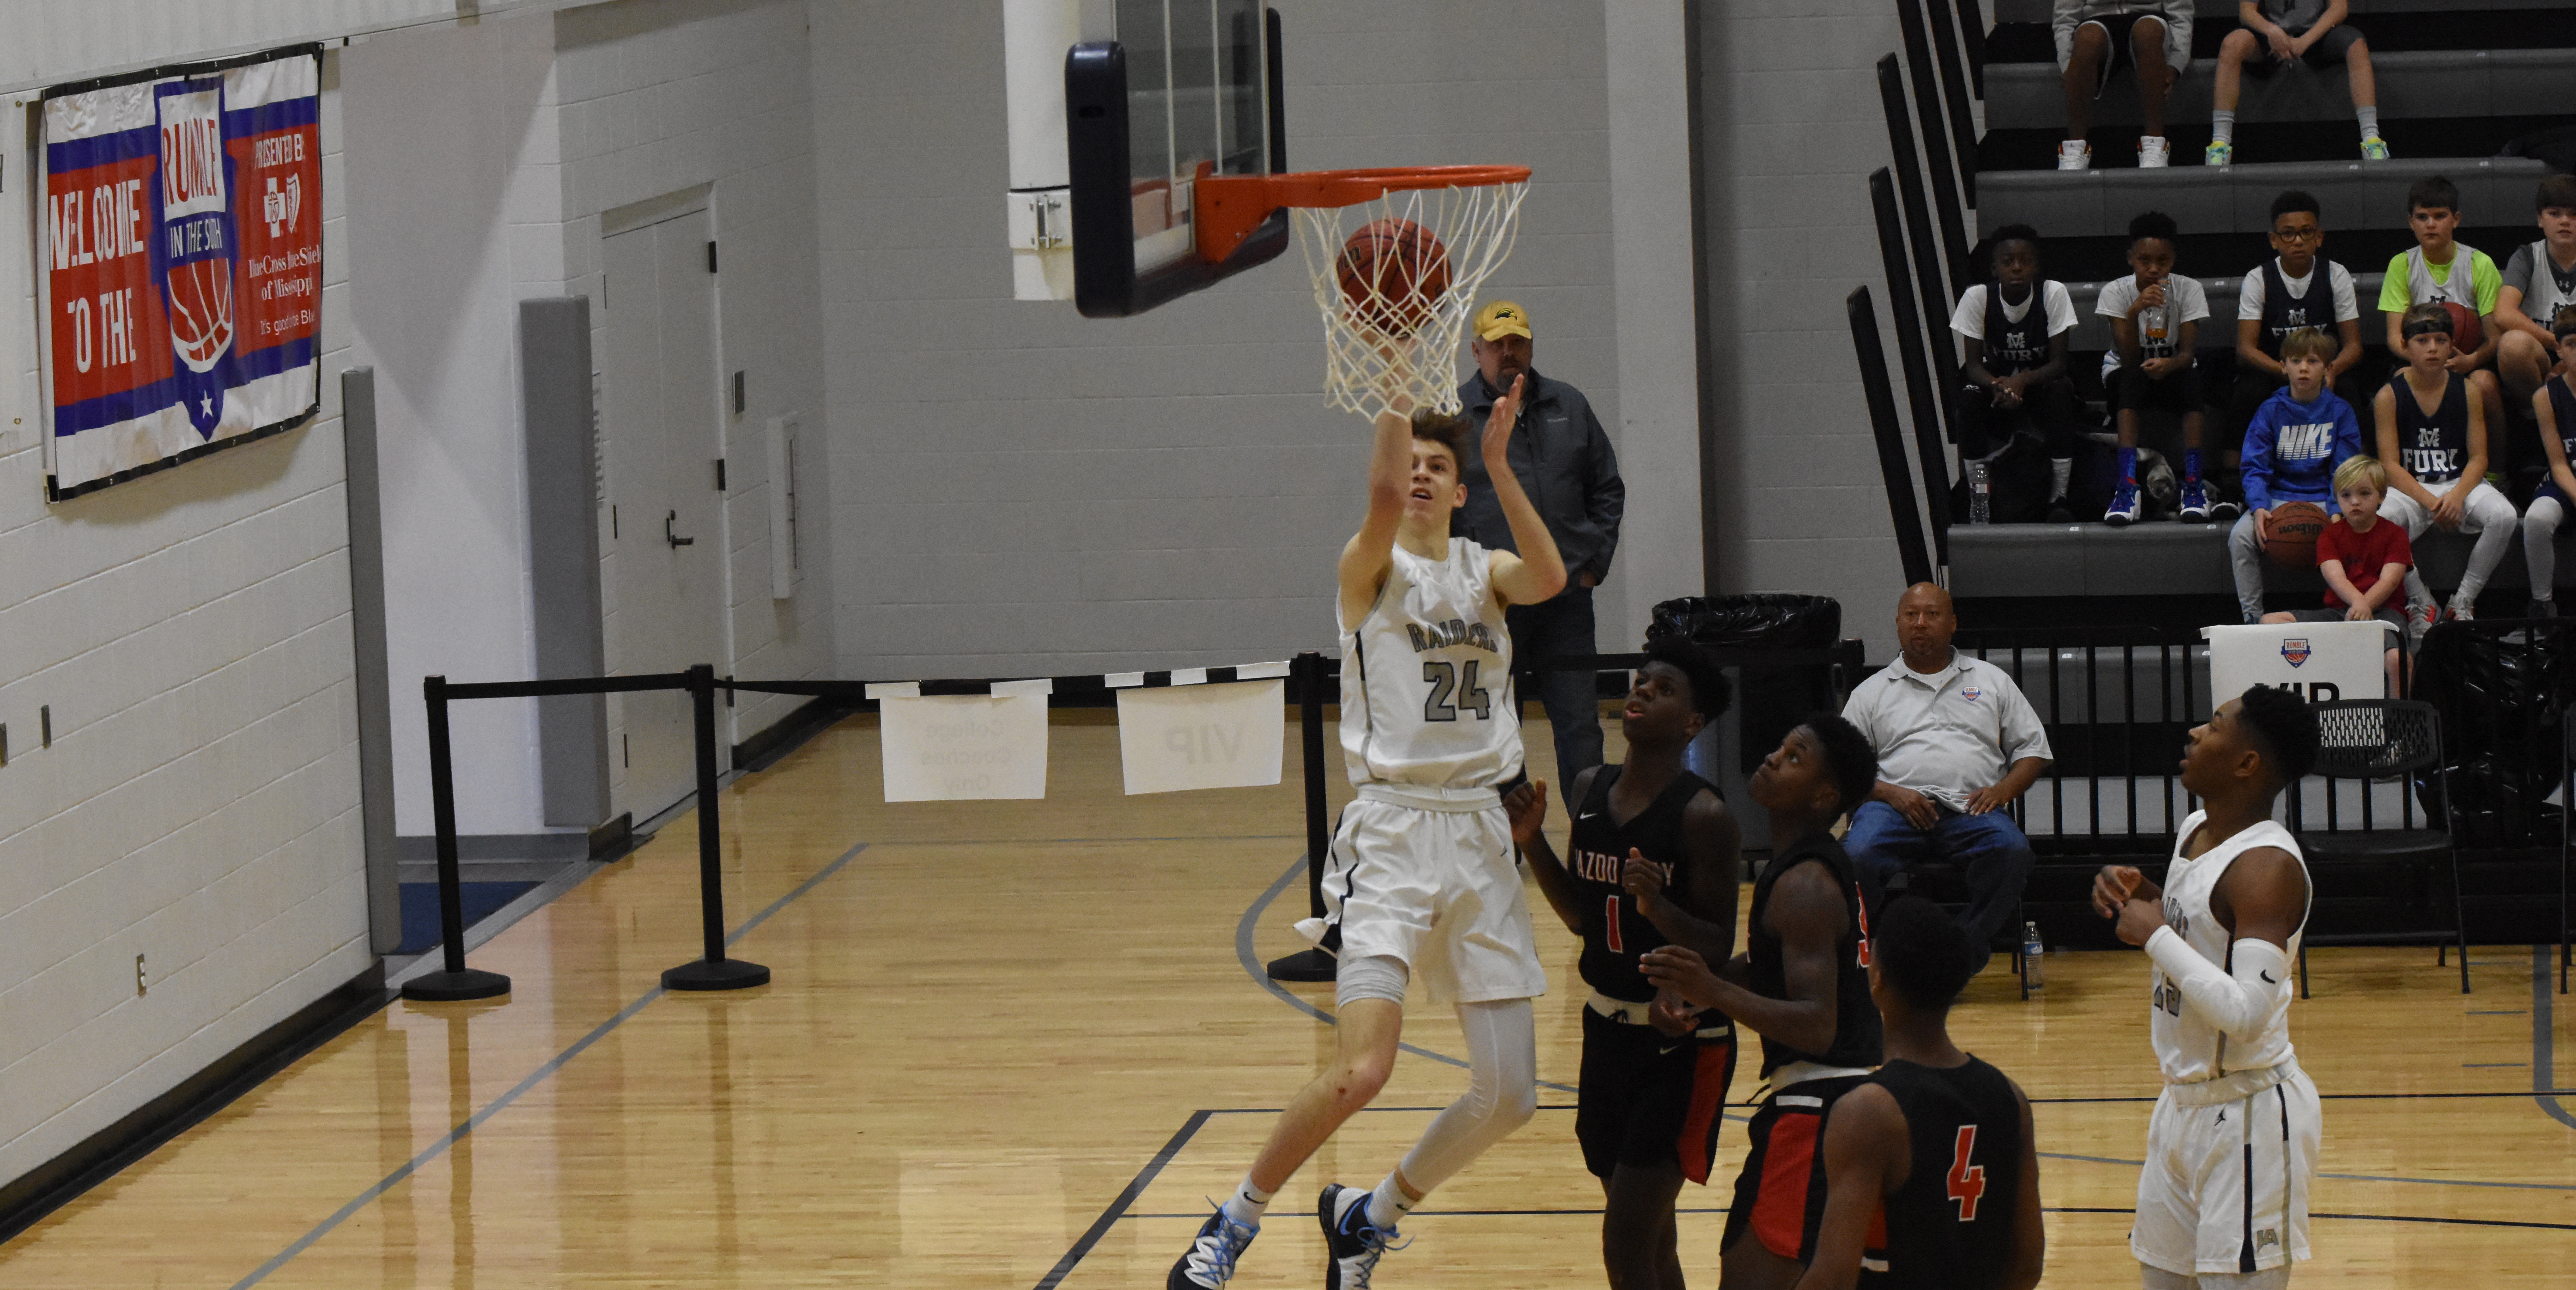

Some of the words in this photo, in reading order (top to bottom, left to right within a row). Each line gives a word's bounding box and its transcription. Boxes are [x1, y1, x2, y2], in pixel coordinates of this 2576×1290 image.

[294, 134, 305, 161] B
[170, 225, 183, 258] IN
[186, 220, 203, 254] THE
[261, 281, 273, 300] of
[100, 288, 136, 367] THE
[2276, 422, 2333, 460] NIKE
[2402, 448, 2458, 473] FURY
[1423, 660, 1490, 722] 24
[1606, 895, 1623, 954] 1
[1947, 1125, 1985, 1222] 4
